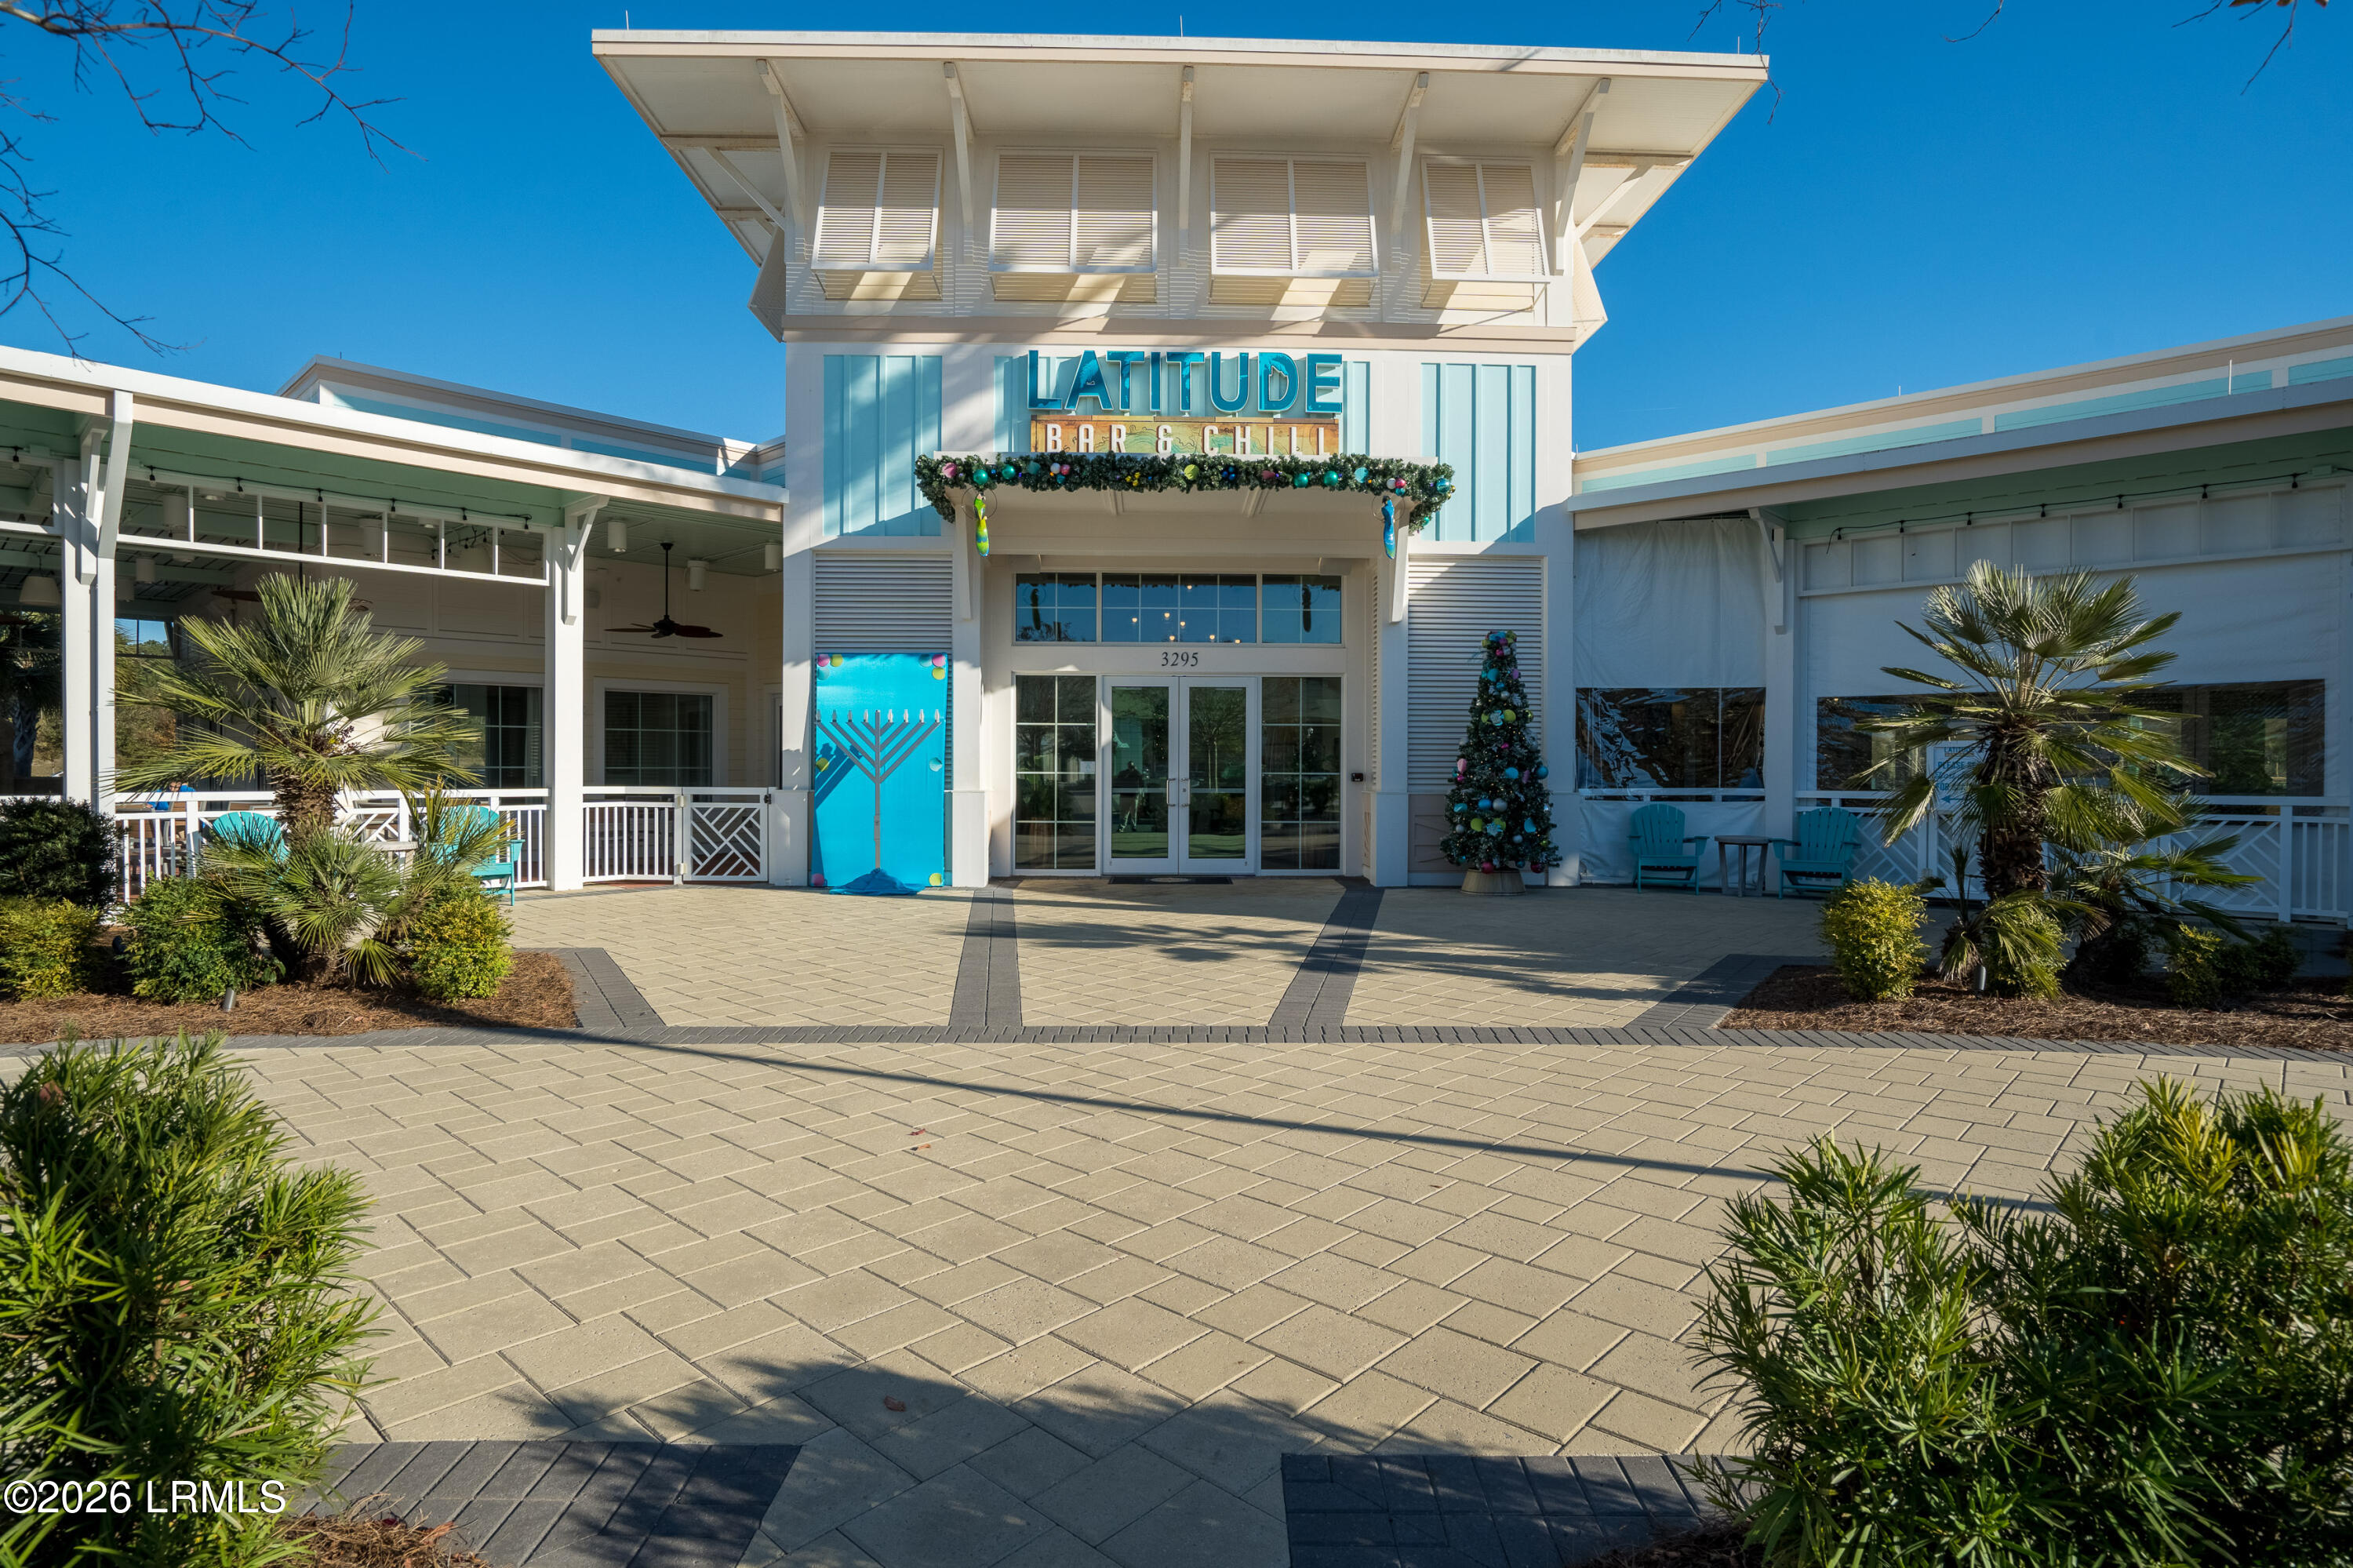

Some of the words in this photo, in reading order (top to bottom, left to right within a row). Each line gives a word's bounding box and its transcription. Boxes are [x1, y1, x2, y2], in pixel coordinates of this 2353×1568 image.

[1027, 350, 1343, 413] LATITUDE
[1046, 424, 1127, 453] BAR
[1156, 424, 1174, 453] &
[1202, 425, 1331, 456] CHILL
[1162, 652, 1198, 667] 3295
